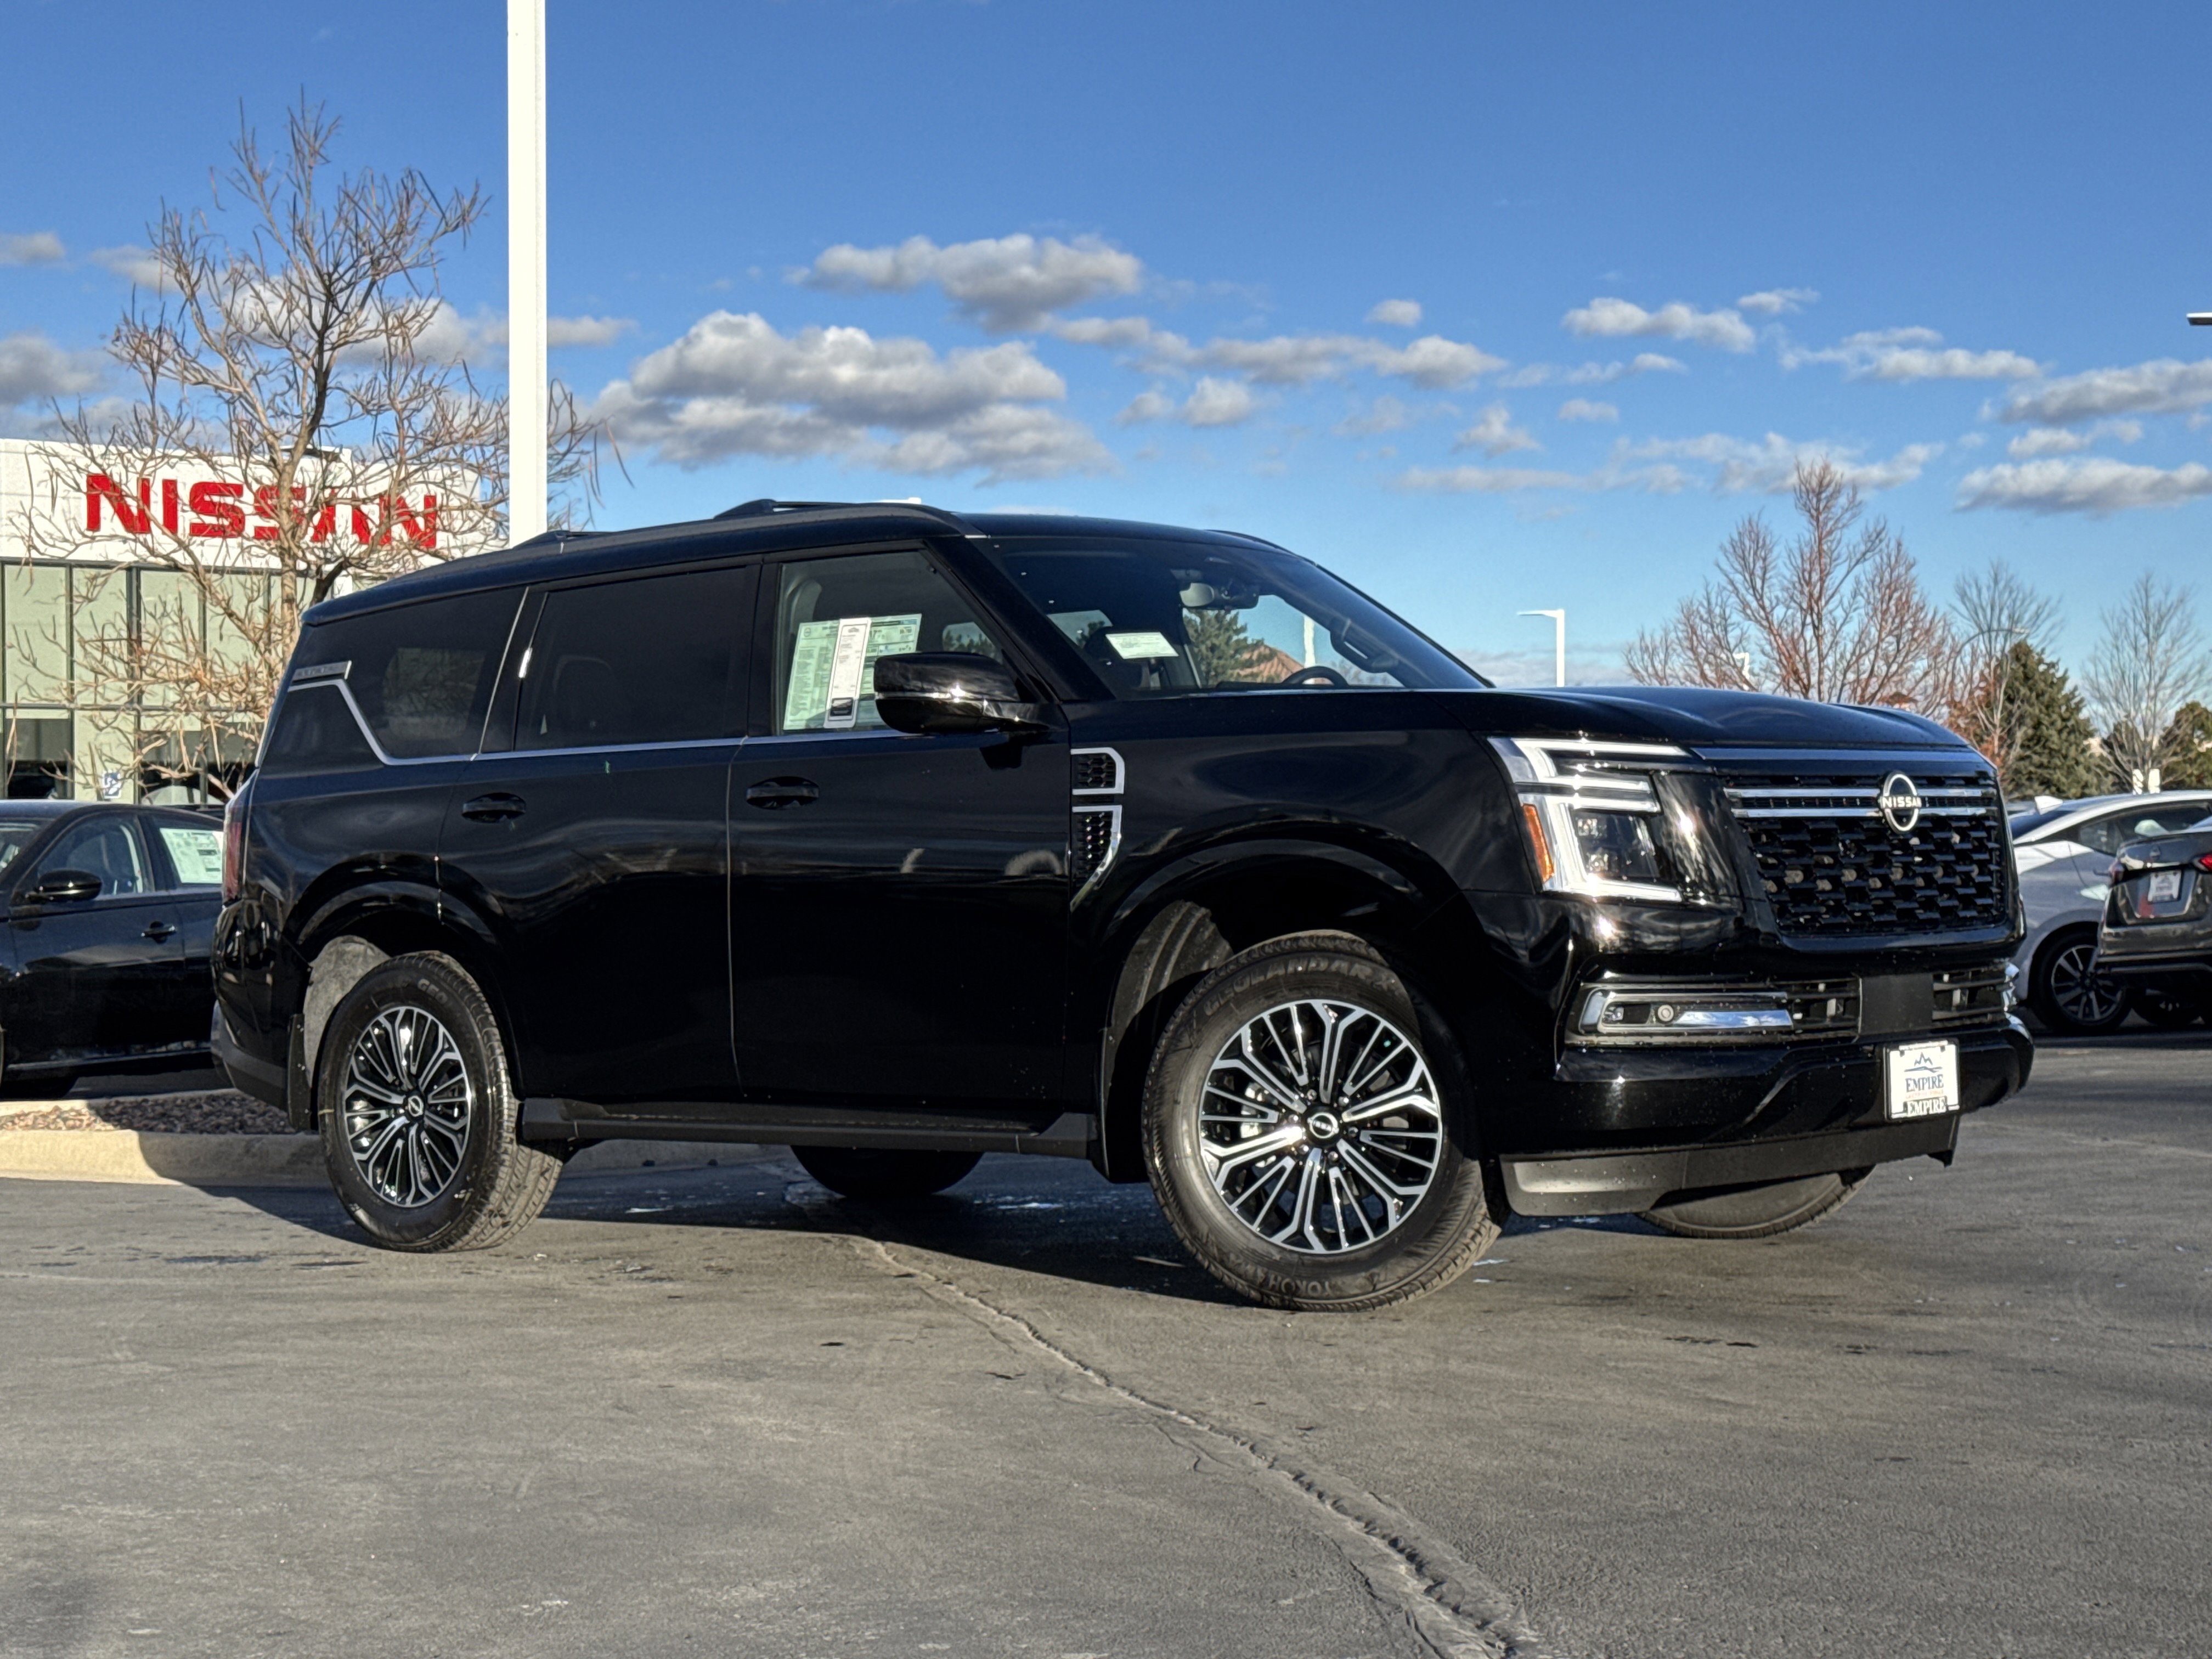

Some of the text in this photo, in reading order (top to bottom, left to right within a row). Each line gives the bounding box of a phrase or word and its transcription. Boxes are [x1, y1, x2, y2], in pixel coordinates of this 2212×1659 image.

[86, 474, 437, 549] NISSAN
[1882, 796, 1922, 808] NISSAN
[1905, 1074, 1944, 1093] EMPIRE
[1906, 1097, 1946, 1115] EMPIRE
